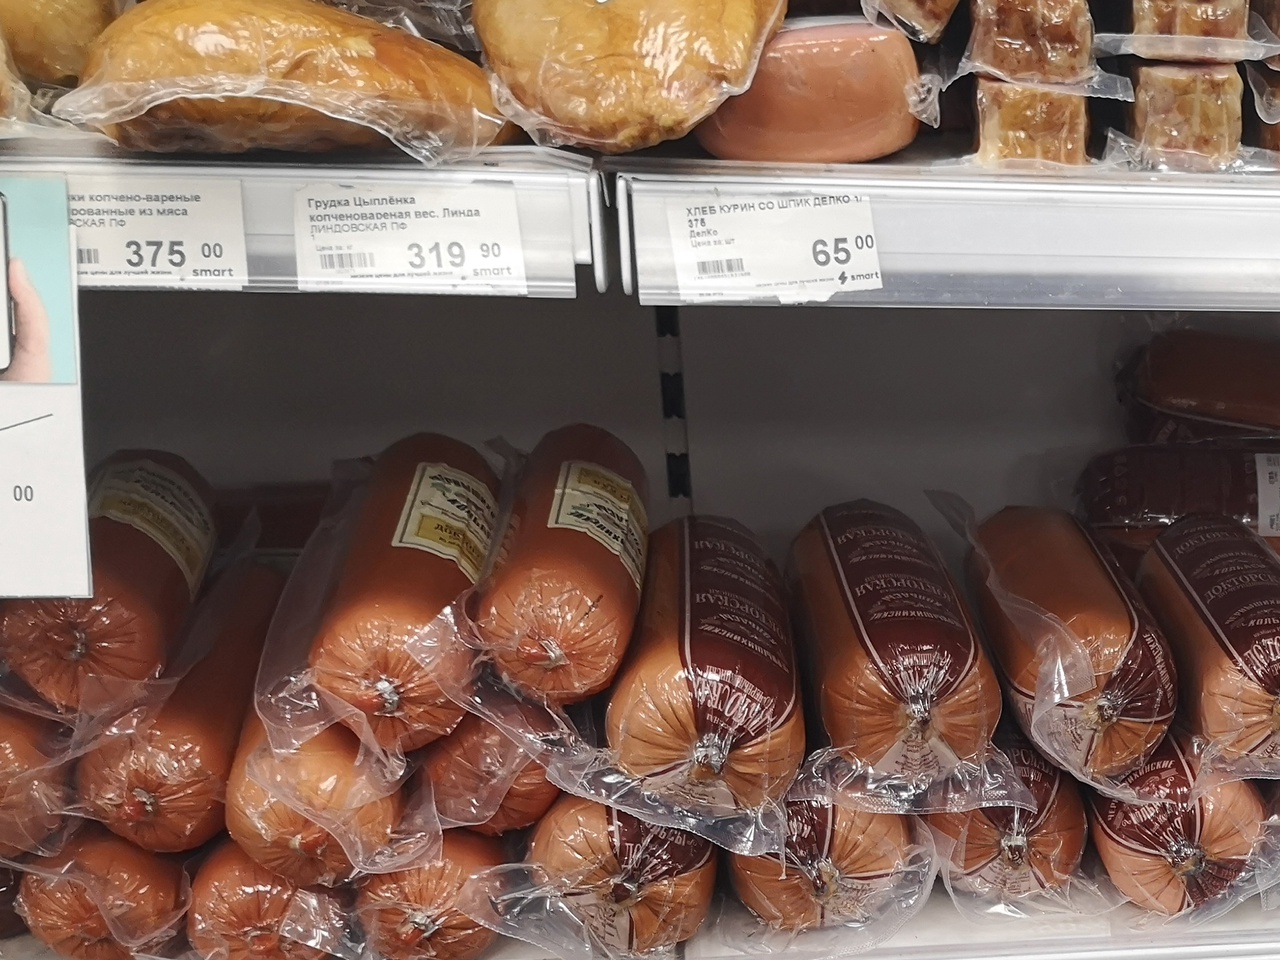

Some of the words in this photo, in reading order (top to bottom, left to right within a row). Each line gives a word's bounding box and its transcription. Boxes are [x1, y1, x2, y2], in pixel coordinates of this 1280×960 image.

[89, 194, 201, 204] копчено-вареные
[308, 199, 350, 210] Грудка
[354, 196, 416, 208] Цыплёнка
[139, 208, 153, 216] из
[157, 208, 188, 216] мяса
[686, 206, 717, 217] ХЛЕБ
[719, 203, 755, 215] КУРИН
[758, 202, 775, 211] СО
[778, 199, 812, 210] ШПИК
[813, 196, 851, 207] ДЕЛКО
[415, 209, 440, 219] вес.
[310, 223, 388, 234] ЛИНДОВСКАЯ
[126, 240, 186, 268] 375
[201, 243, 223, 259] 00
[407, 241, 466, 270] 319
[479, 242, 502, 259] 90
[812, 238, 852, 267] 65
[855, 234, 875, 250] 00
[192, 268, 234, 277] smart
[473, 267, 512, 277] smart
[851, 271, 880, 282] smart
[13, 485, 35, 503] 00
